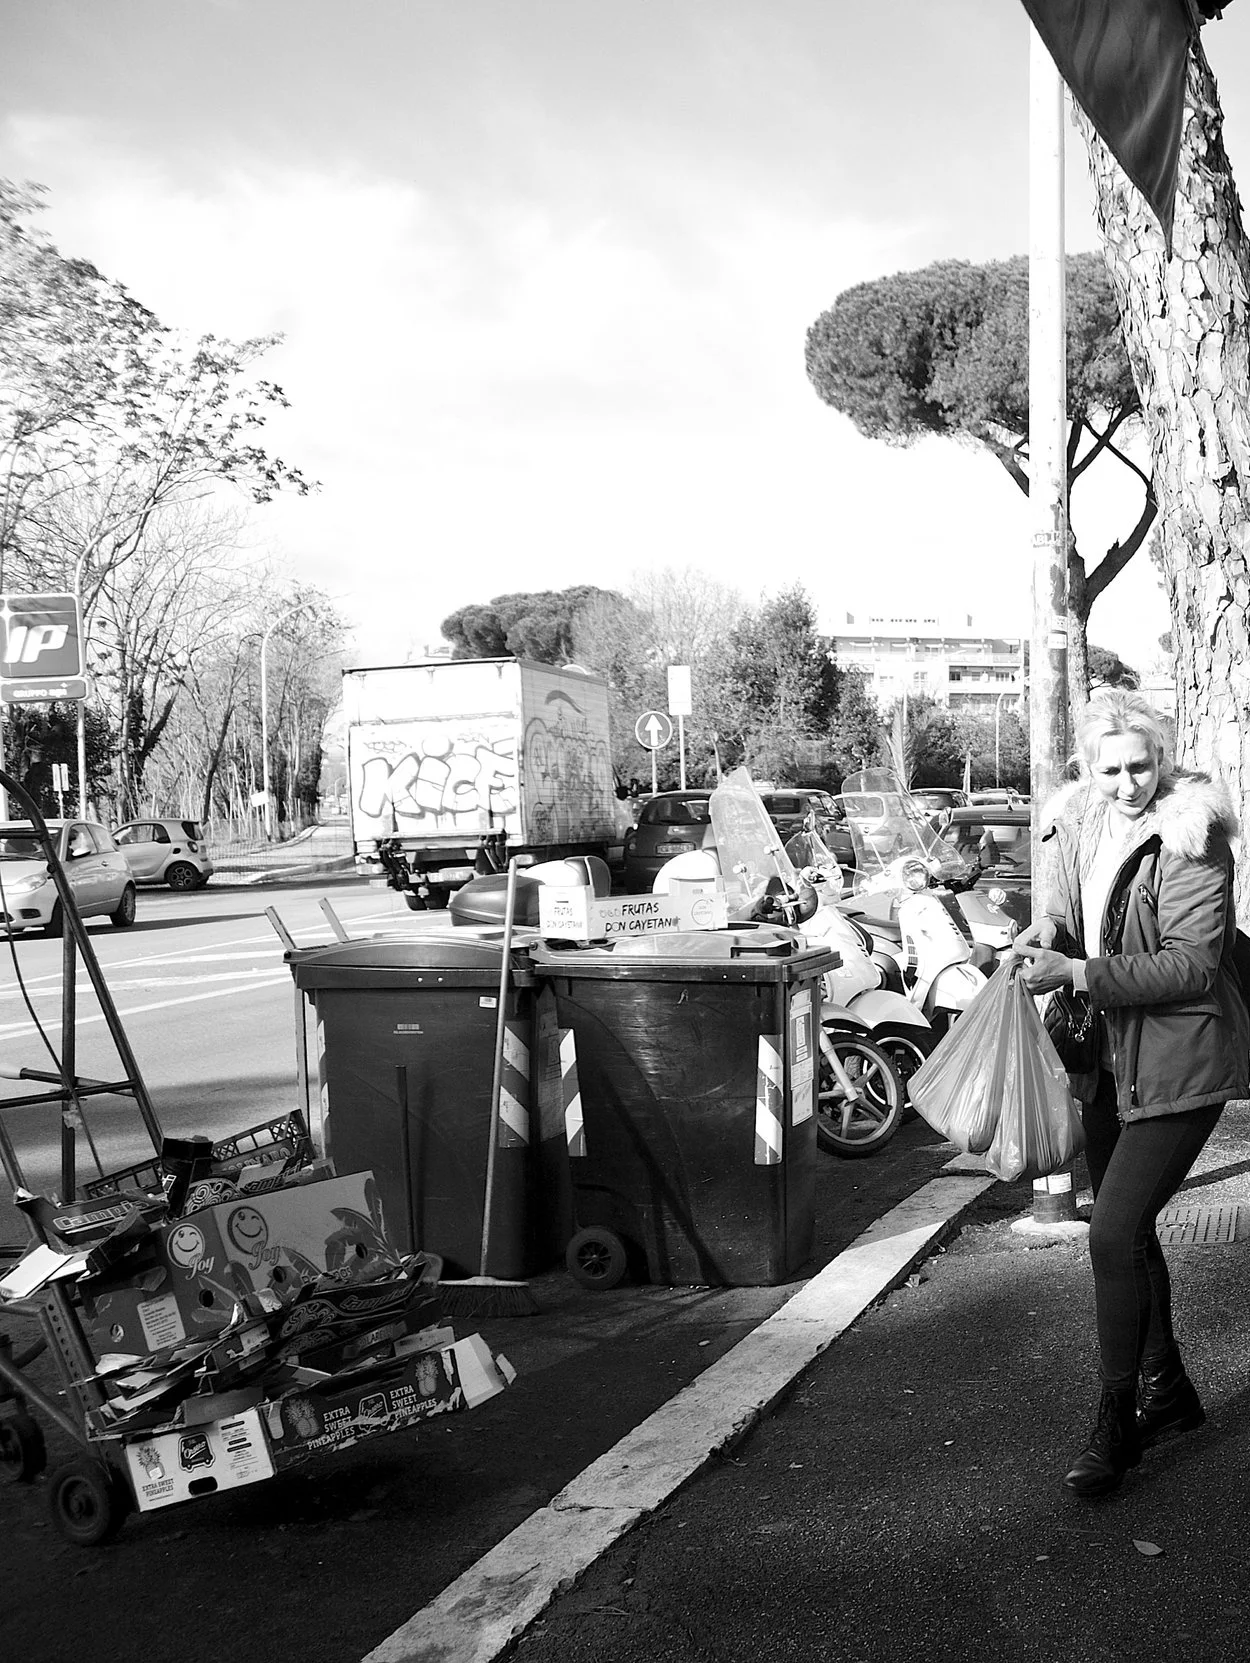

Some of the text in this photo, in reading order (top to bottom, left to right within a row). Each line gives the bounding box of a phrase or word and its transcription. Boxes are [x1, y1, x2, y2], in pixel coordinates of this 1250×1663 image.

[3, 624, 69, 664] IP
[621, 902, 660, 917] FRUTAS
[605, 921, 626, 933] DON
[248, 1241, 281, 1270] Joy
[184, 1253, 216, 1281] Joy
[388, 1384, 415, 1401] EXTRA
[391, 1394, 418, 1411] SWEET
[394, 1397, 438, 1420] PINEAPPLES
[322, 1405, 351, 1423] EXTRA
[323, 1416, 353, 1434] SWEET
[306, 1426, 356, 1451] PINEAPPLES
